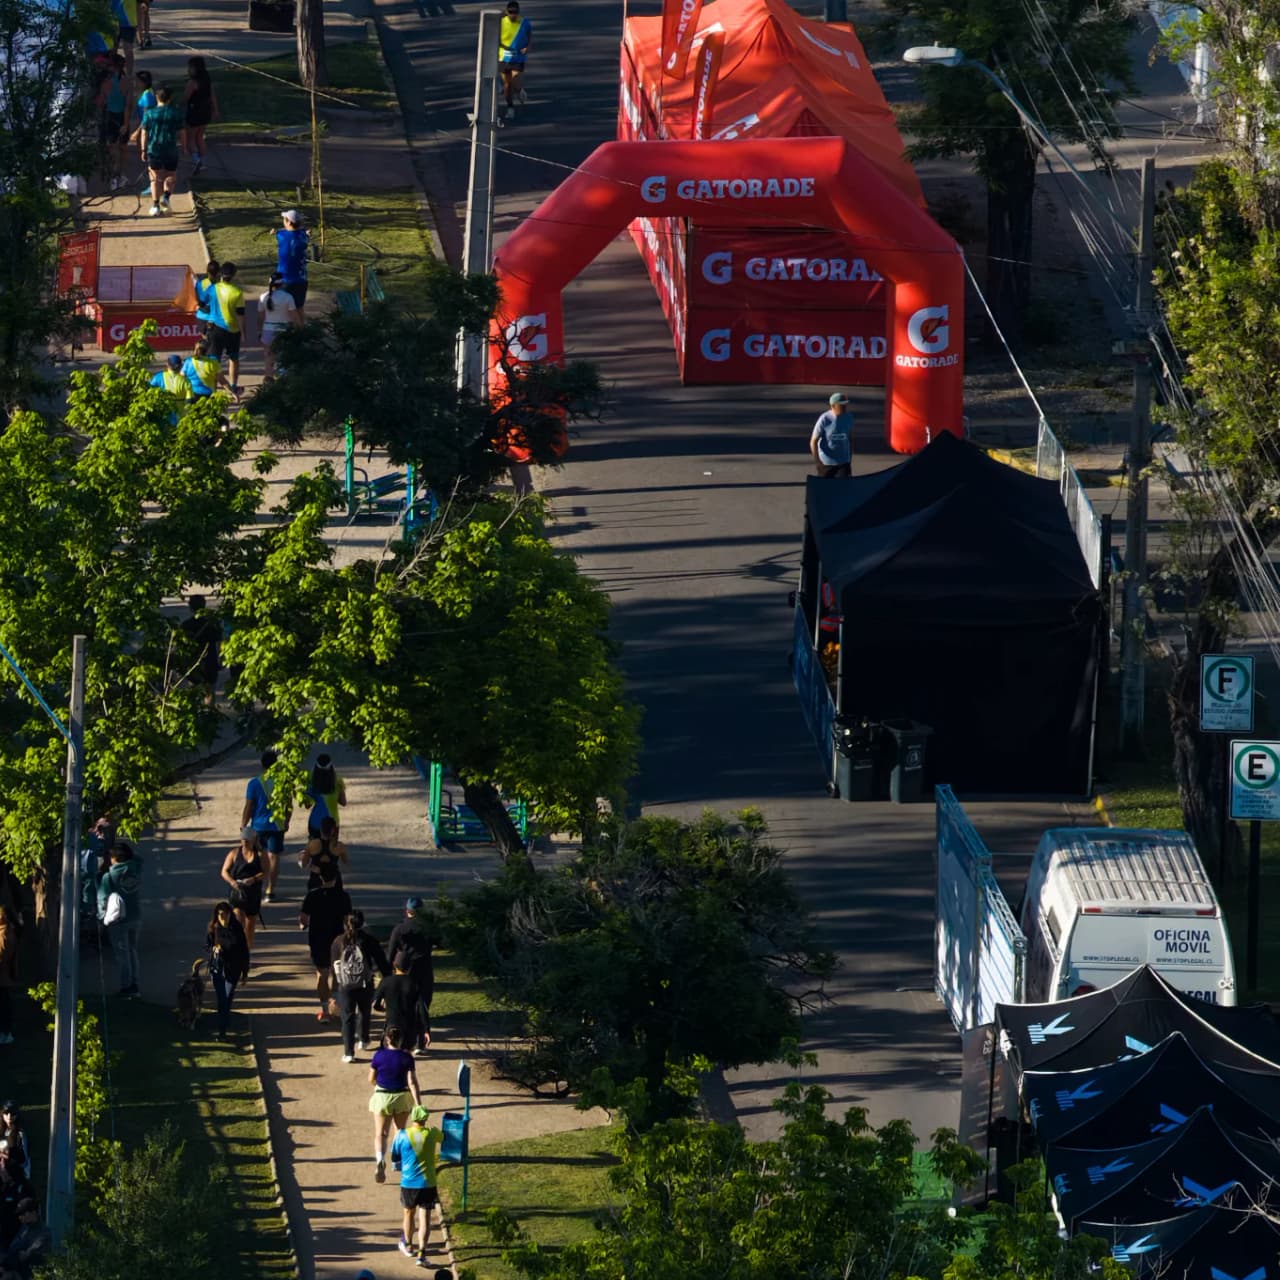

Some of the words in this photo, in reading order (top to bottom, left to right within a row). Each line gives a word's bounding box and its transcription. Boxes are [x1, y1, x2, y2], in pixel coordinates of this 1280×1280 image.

[677, 178, 815, 200] GATORADE
[701, 251, 732, 285] G
[744, 257, 885, 282] GATORA
[907, 304, 950, 354] G
[700, 328, 731, 363] G
[743, 334, 888, 360] GATORAD
[895, 354, 959, 369] GATORADE
[1218, 667, 1237, 694] F
[1248, 753, 1267, 780] E
[1154, 929, 1211, 942] OFICINA
[1165, 941, 1211, 954] MOVIL
